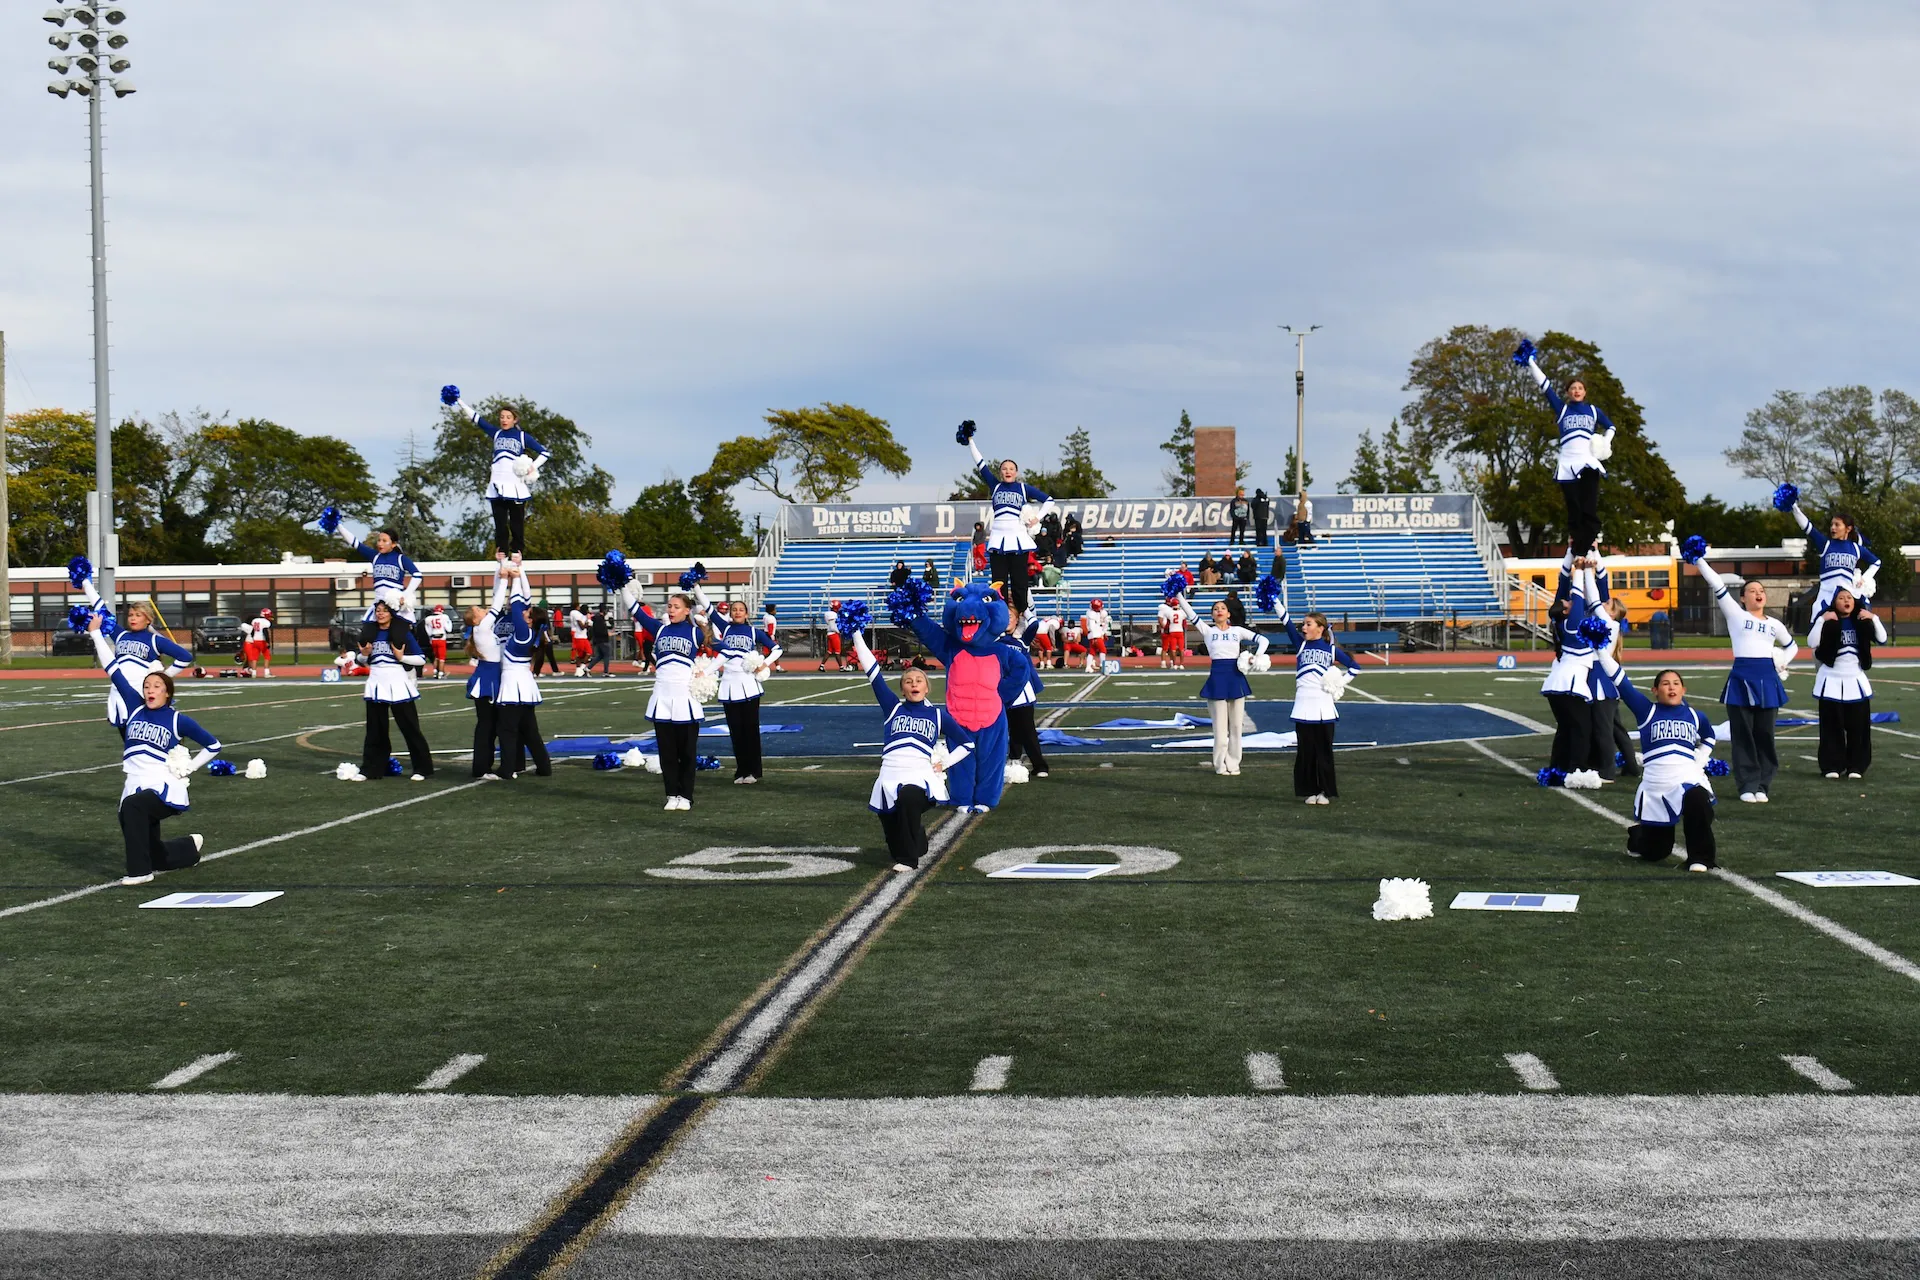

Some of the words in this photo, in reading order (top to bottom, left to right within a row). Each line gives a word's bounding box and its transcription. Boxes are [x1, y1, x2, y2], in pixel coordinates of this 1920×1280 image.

[1352, 498, 1406, 512] HOME
[1410, 497, 1435, 512] OF
[812, 505, 911, 527] DIVISION
[935, 505, 955, 534] D
[1082, 503, 1152, 529] BLUE
[1327, 513, 1365, 528] THE
[1369, 512, 1460, 528] DRAGONS
[818, 525, 849, 535] HIGH
[853, 524, 905, 535] SCHOOL
[431, 618, 442, 629] 15
[1172, 613, 1180, 624] 2
[658, 635, 692, 656] DRAGONS
[1104, 660, 1120, 674] 50
[1501, 655, 1516, 669] 40
[323, 669, 340, 682] 30
[127, 720, 172, 749] DRAGONS
[890, 714, 936, 742] DRAGONS
